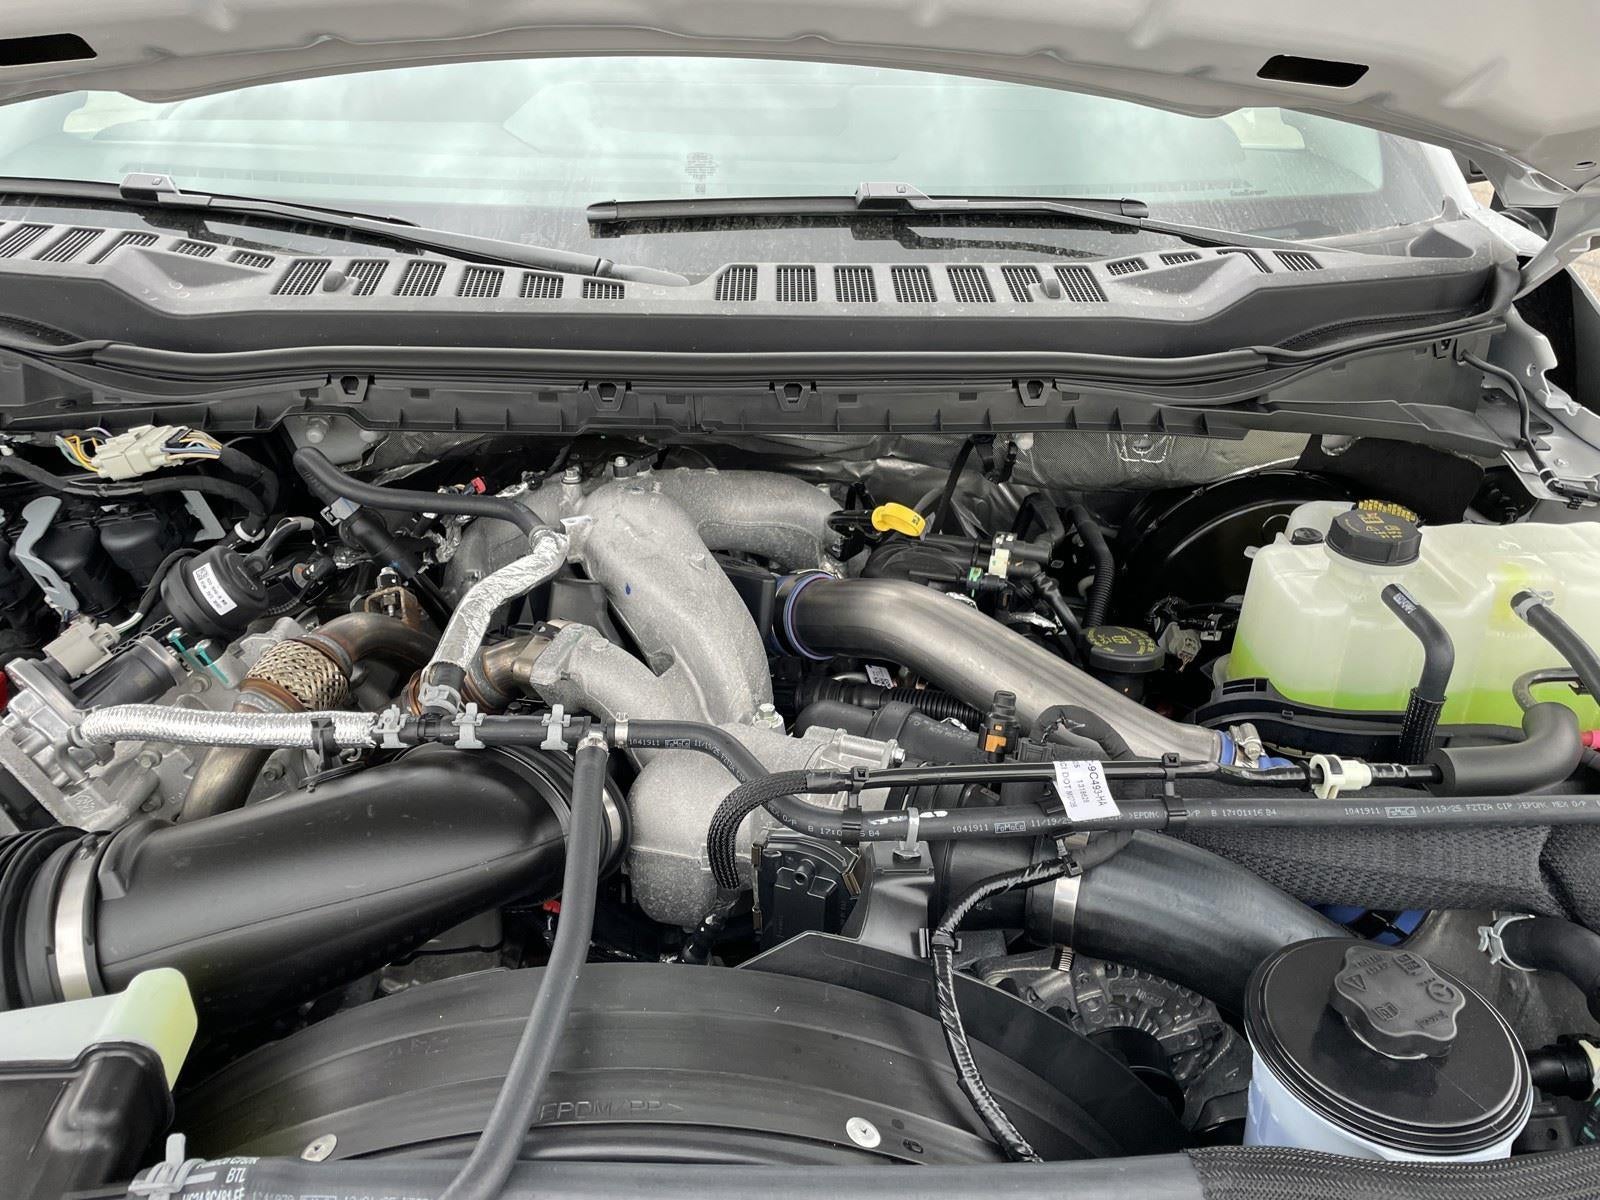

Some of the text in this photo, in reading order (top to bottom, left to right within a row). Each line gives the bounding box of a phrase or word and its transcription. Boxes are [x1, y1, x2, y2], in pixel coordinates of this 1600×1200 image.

[629, 738, 660, 747] 1041911
[1062, 772, 1071, 789] DOT
[1344, 807, 1380, 816] 1041911
[952, 823, 989, 833] 1041911
[994, 821, 1026, 833] FoMoCo
[1031, 816, 1073, 827] 11/19/25
[225, 1167, 247, 1184] BTL
